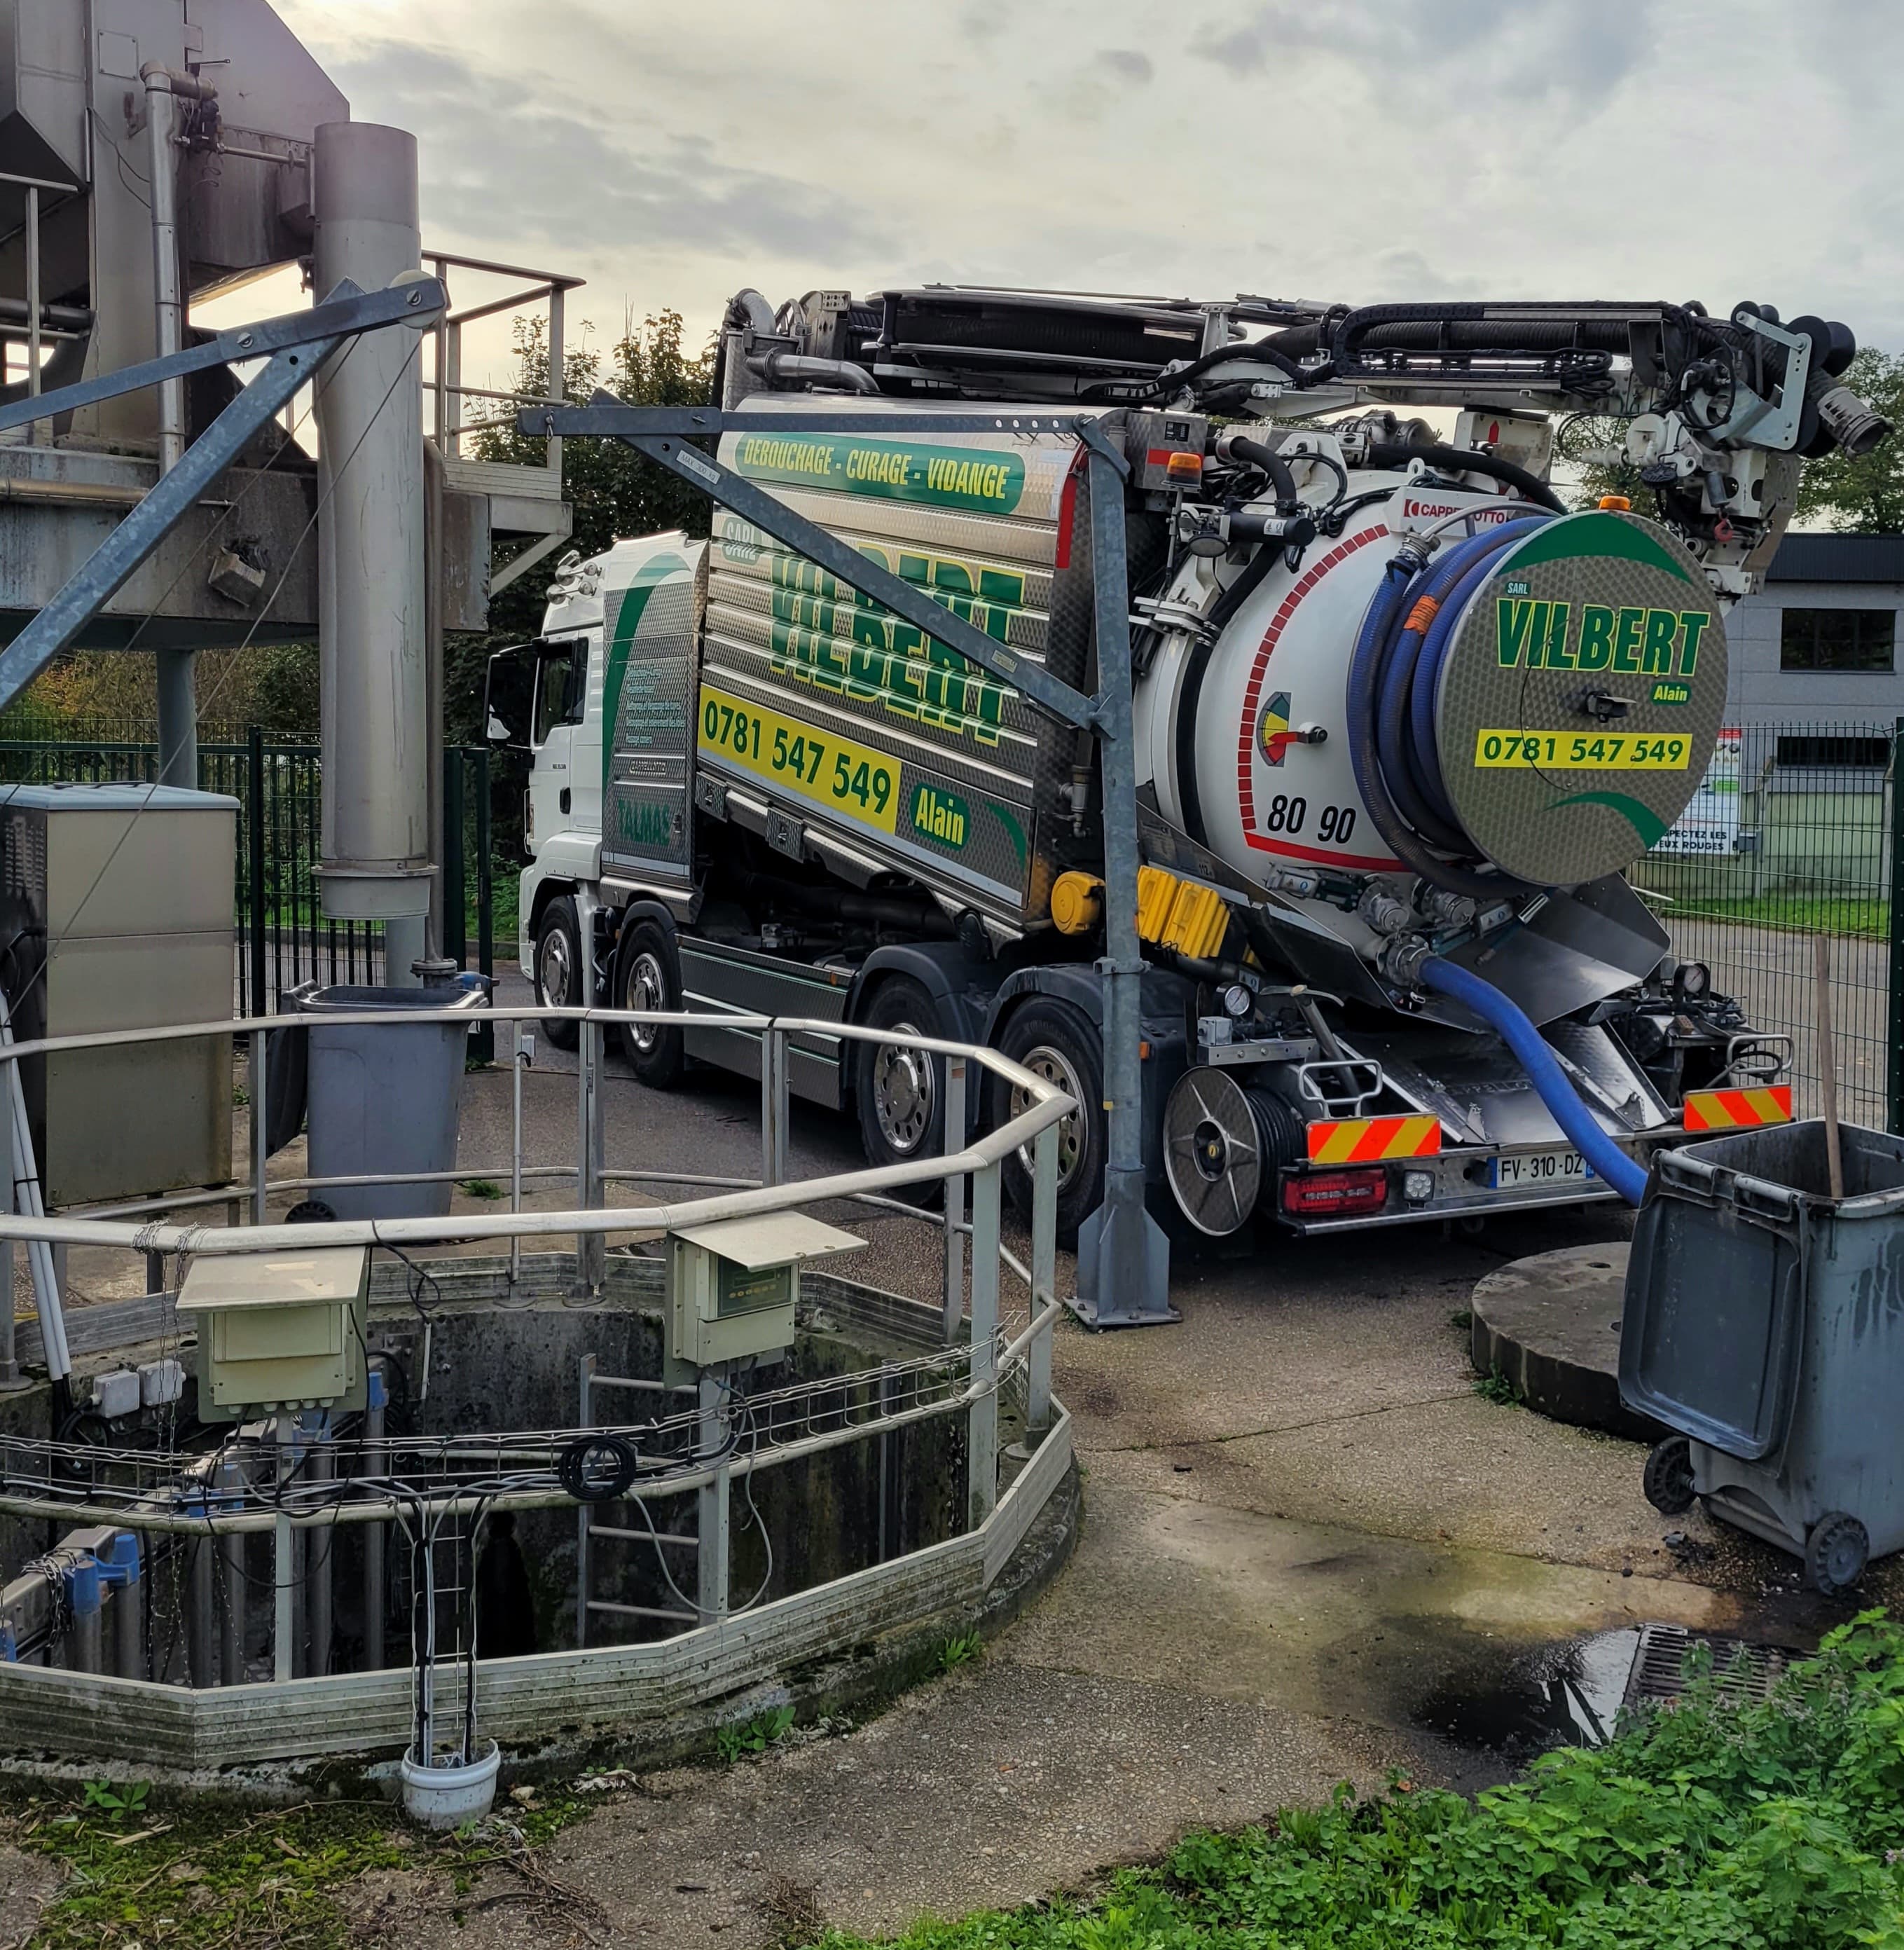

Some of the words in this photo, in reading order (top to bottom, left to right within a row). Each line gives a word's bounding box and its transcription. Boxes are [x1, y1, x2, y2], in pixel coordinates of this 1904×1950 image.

[744, 438, 835, 475] DEBOUCHAGE
[846, 449, 912, 486] CURAGE
[927, 458, 1010, 500] VIDANGE
[1421, 504, 1505, 524] CAPPOTTO
[1507, 582, 1528, 595] SARL
[1496, 598, 1711, 677] VILBERT
[1654, 684, 1688, 701] Alain
[704, 700, 761, 760] 0781
[772, 728, 825, 785] 547
[832, 752, 892, 814] 549
[1484, 736, 1556, 761] 0781
[1570, 739, 1622, 762] 547
[1633, 740, 1684, 762] 549
[915, 788, 965, 846] Alain
[1267, 795, 1306, 834] 80
[1318, 806, 1356, 844] 90
[1682, 841, 1724, 850] ROUGES
